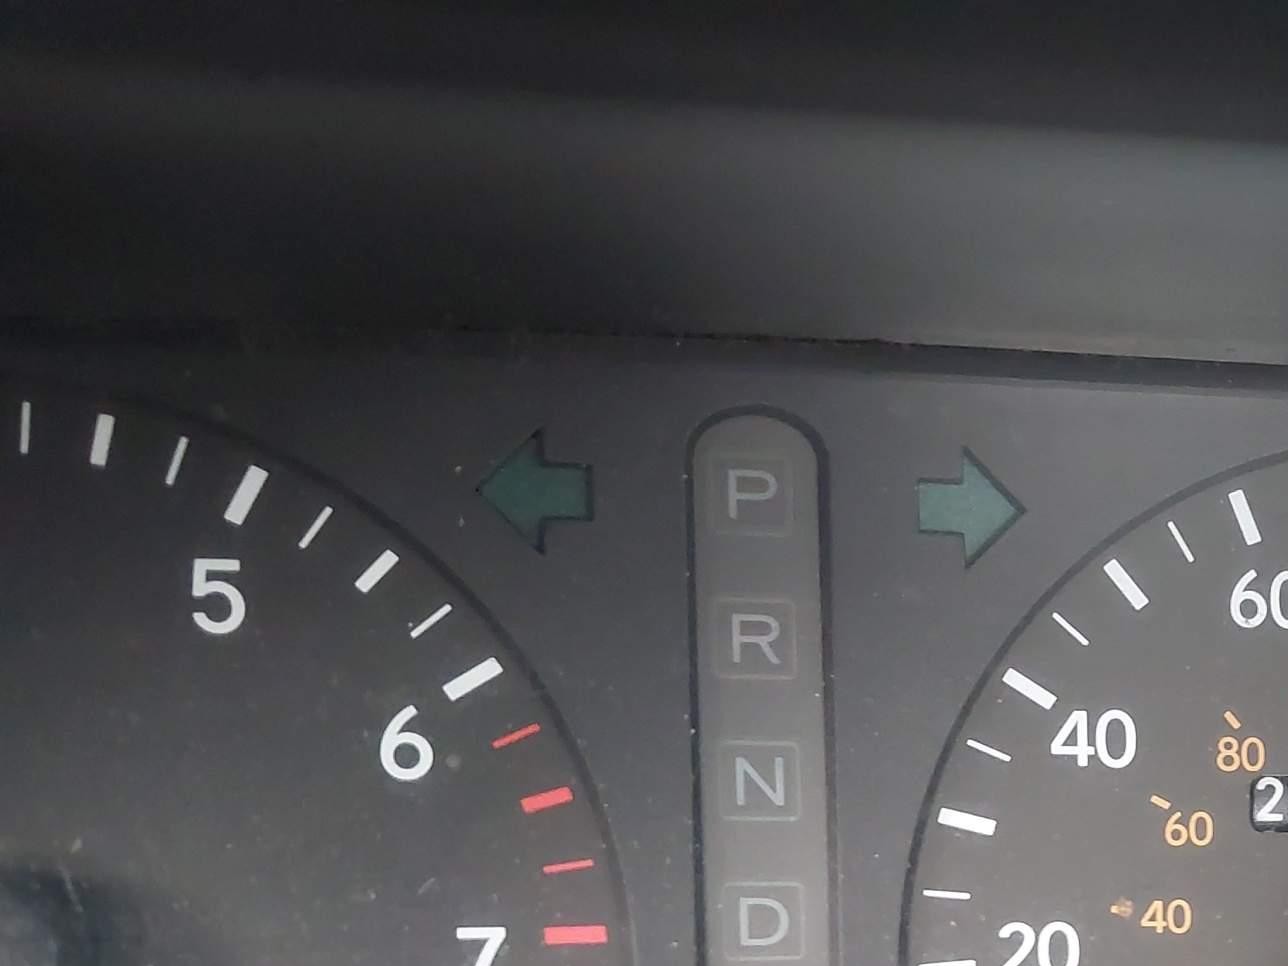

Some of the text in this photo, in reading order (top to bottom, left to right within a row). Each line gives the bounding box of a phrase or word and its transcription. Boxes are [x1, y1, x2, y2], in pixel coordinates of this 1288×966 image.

[727, 469, 779, 519] P
[192, 559, 245, 634] 5
[732, 614, 781, 665] R
[380, 705, 433, 781] 6
[1051, 710, 1136, 768] 40
[1217, 737, 1264, 771] 80
[736, 757, 785, 806] N
[1165, 812, 1213, 846] 60
[739, 897, 789, 946] D
[1141, 900, 1191, 934] 40
